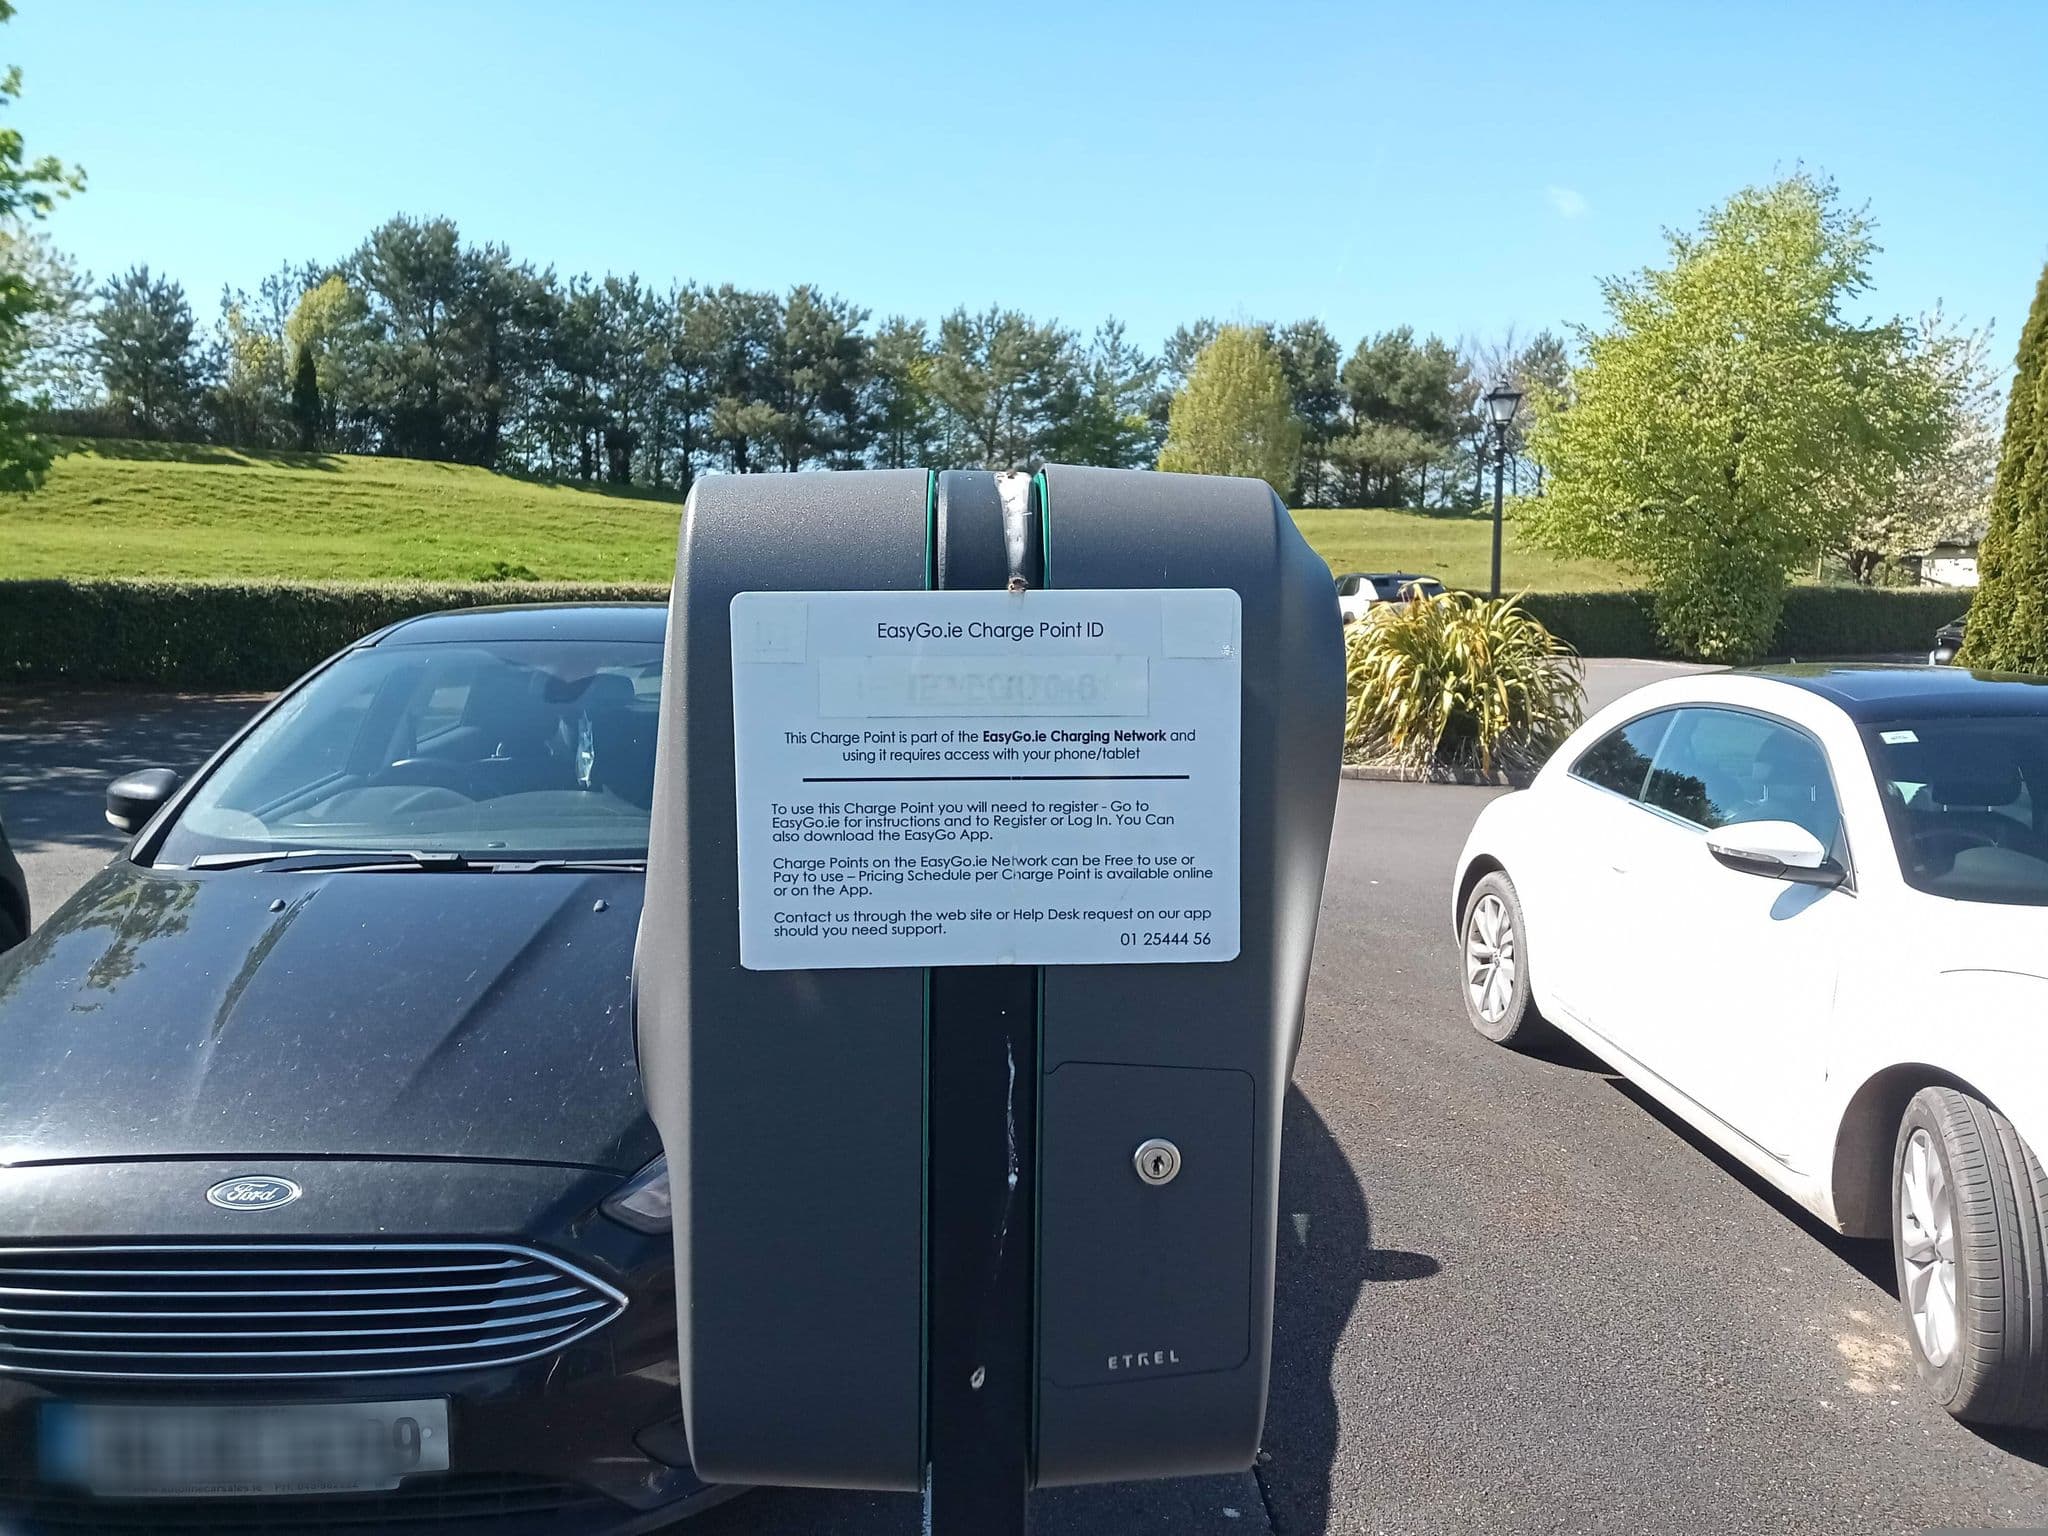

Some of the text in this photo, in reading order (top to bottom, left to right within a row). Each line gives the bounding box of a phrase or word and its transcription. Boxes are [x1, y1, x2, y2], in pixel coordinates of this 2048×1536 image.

[878, 622, 1103, 641] EasyGo.ie Charge Point ID
[784, 731, 1195, 747] This Charge Point is part of the EasyGo.ie Charging Network and
[843, 749, 1140, 765] using it requires access with your phone/tablet
[771, 803, 787, 815] To
[792, 805, 814, 814] use
[818, 803, 840, 814] this
[844, 802, 896, 817] Charge
[901, 802, 934, 814] Point
[938, 804, 963, 817] you
[967, 802, 987, 813] will
[992, 801, 1027, 813] need
[1032, 801, 1045, 813] to
[1049, 801, 1098, 816] register
[1111, 801, 1131, 812] Go
[1136, 800, 1149, 812] to
[773, 814, 1174, 831] EasyGo.ie for instructions and to Register or Log In. You Can
[773, 829, 992, 844] also download the EasyGo App.
[773, 854, 1195, 872] Charge Points on the EasyGo.ie Network can be Free to use or
[774, 871, 799, 886] Pay
[803, 871, 816, 883] to
[821, 873, 843, 882] use
[859, 870, 903, 885] Pricing
[908, 870, 971, 881] Schedule
[976, 872, 998, 884] per
[1002, 869, 1053, 884] Charge
[1058, 868, 1090, 880] Point
[1095, 868, 1102, 880] is
[1107, 868, 1169, 879] available
[1173, 867, 1213, 879] online
[774, 884, 872, 899] or on the App.
[774, 909, 1211, 926] Contact us through the web site or Help Desk request on our app
[774, 923, 946, 939] should you need support.
[1121, 932, 1211, 946] 01 25444 56
[226, 1183, 280, 1201] Ford
[1107, 1349, 1180, 1370] ETREL
